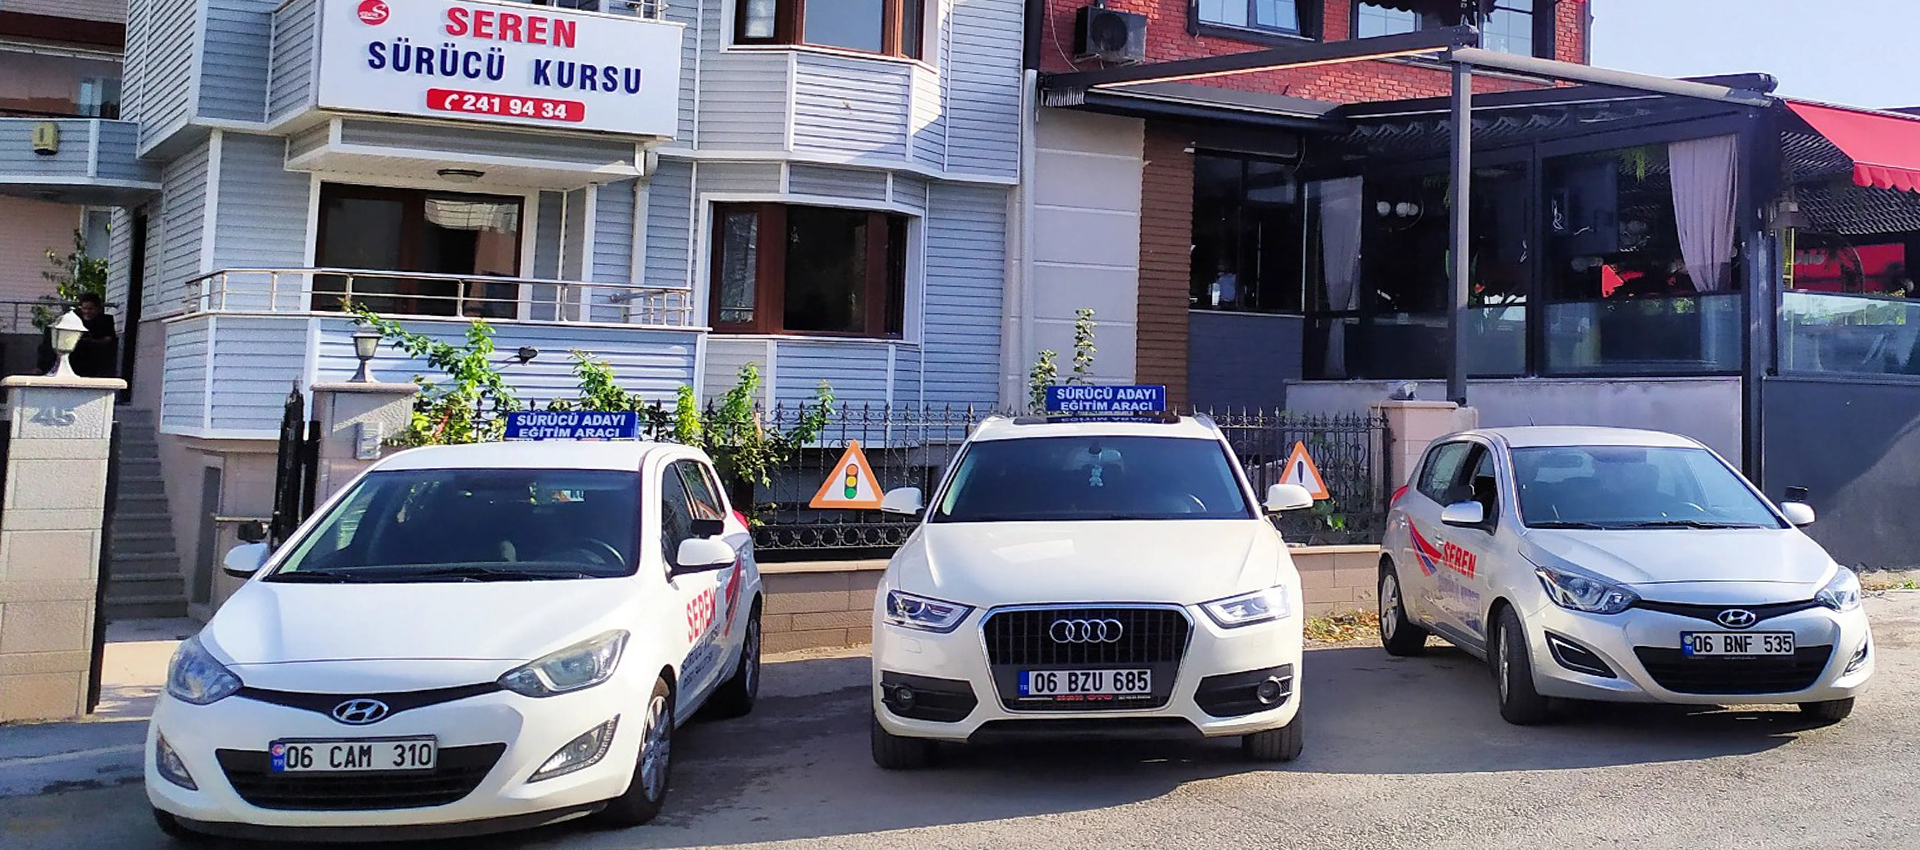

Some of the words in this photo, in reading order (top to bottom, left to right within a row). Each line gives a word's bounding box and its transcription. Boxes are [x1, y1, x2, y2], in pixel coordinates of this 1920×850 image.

[446, 6, 577, 49] SEREN
[368, 37, 506, 81] SÜRÜCÜ
[533, 58, 642, 95] KURSU
[462, 94, 501, 114] 241
[509, 97, 535, 115] 94
[541, 101, 567, 119] 34
[1056, 386, 1113, 400] SÜRÜCÜ
[1116, 388, 1156, 400] ADAYI
[1060, 400, 1108, 411] EĞİTİM
[1112, 401, 1153, 411] ARACI
[516, 412, 579, 426] SÜRÜCÜ
[581, 414, 626, 426] ADAYI
[518, 426, 572, 438] EĞİTİM
[574, 428, 620, 438] ARACI
[1443, 541, 1477, 580] SEREN
[687, 587, 716, 643] SEREN
[1693, 635, 1714, 653] 06
[1723, 635, 1753, 653] BNF
[1764, 635, 1792, 653] 535
[1034, 671, 1058, 693] 06
[1067, 671, 1103, 692] BZU
[1113, 671, 1148, 692] 685
[286, 745, 314, 769] 06
[329, 744, 372, 768] CAM
[392, 743, 432, 767] 310
